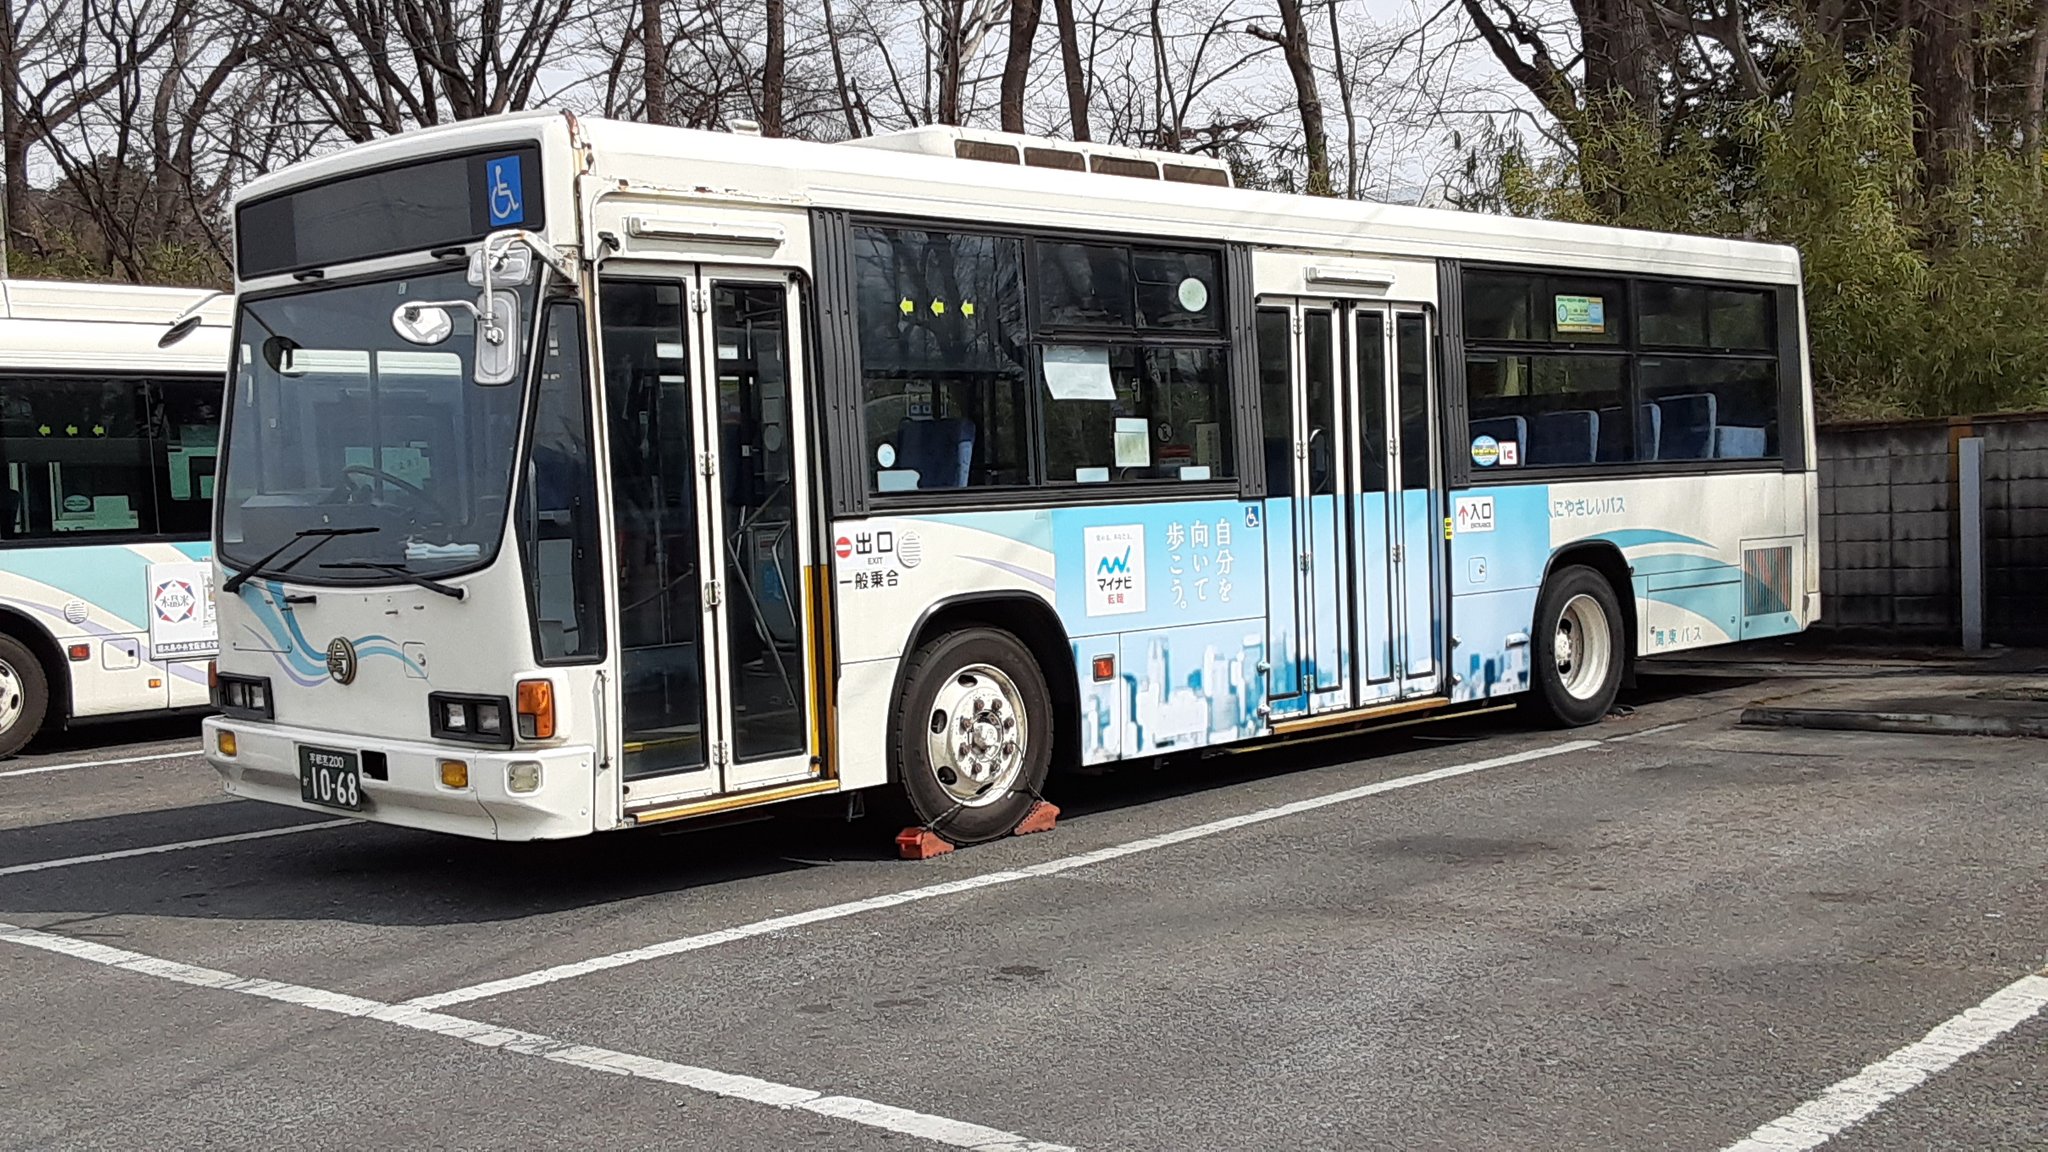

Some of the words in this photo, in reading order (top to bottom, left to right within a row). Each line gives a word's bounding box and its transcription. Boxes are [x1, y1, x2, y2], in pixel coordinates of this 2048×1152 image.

[1470, 503, 1492, 520] 入口
[856, 531, 894, 554] 出口
[868, 557, 883, 565] EXIT
[1166, 521, 1187, 609] 歩こう。
[1190, 519, 1209, 600] 向いて
[1215, 517, 1234, 602] 自分を
[839, 569, 899, 590] 一般乗合
[1097, 576, 1132, 591] マイナビ
[311, 766, 358, 806] 10-68
